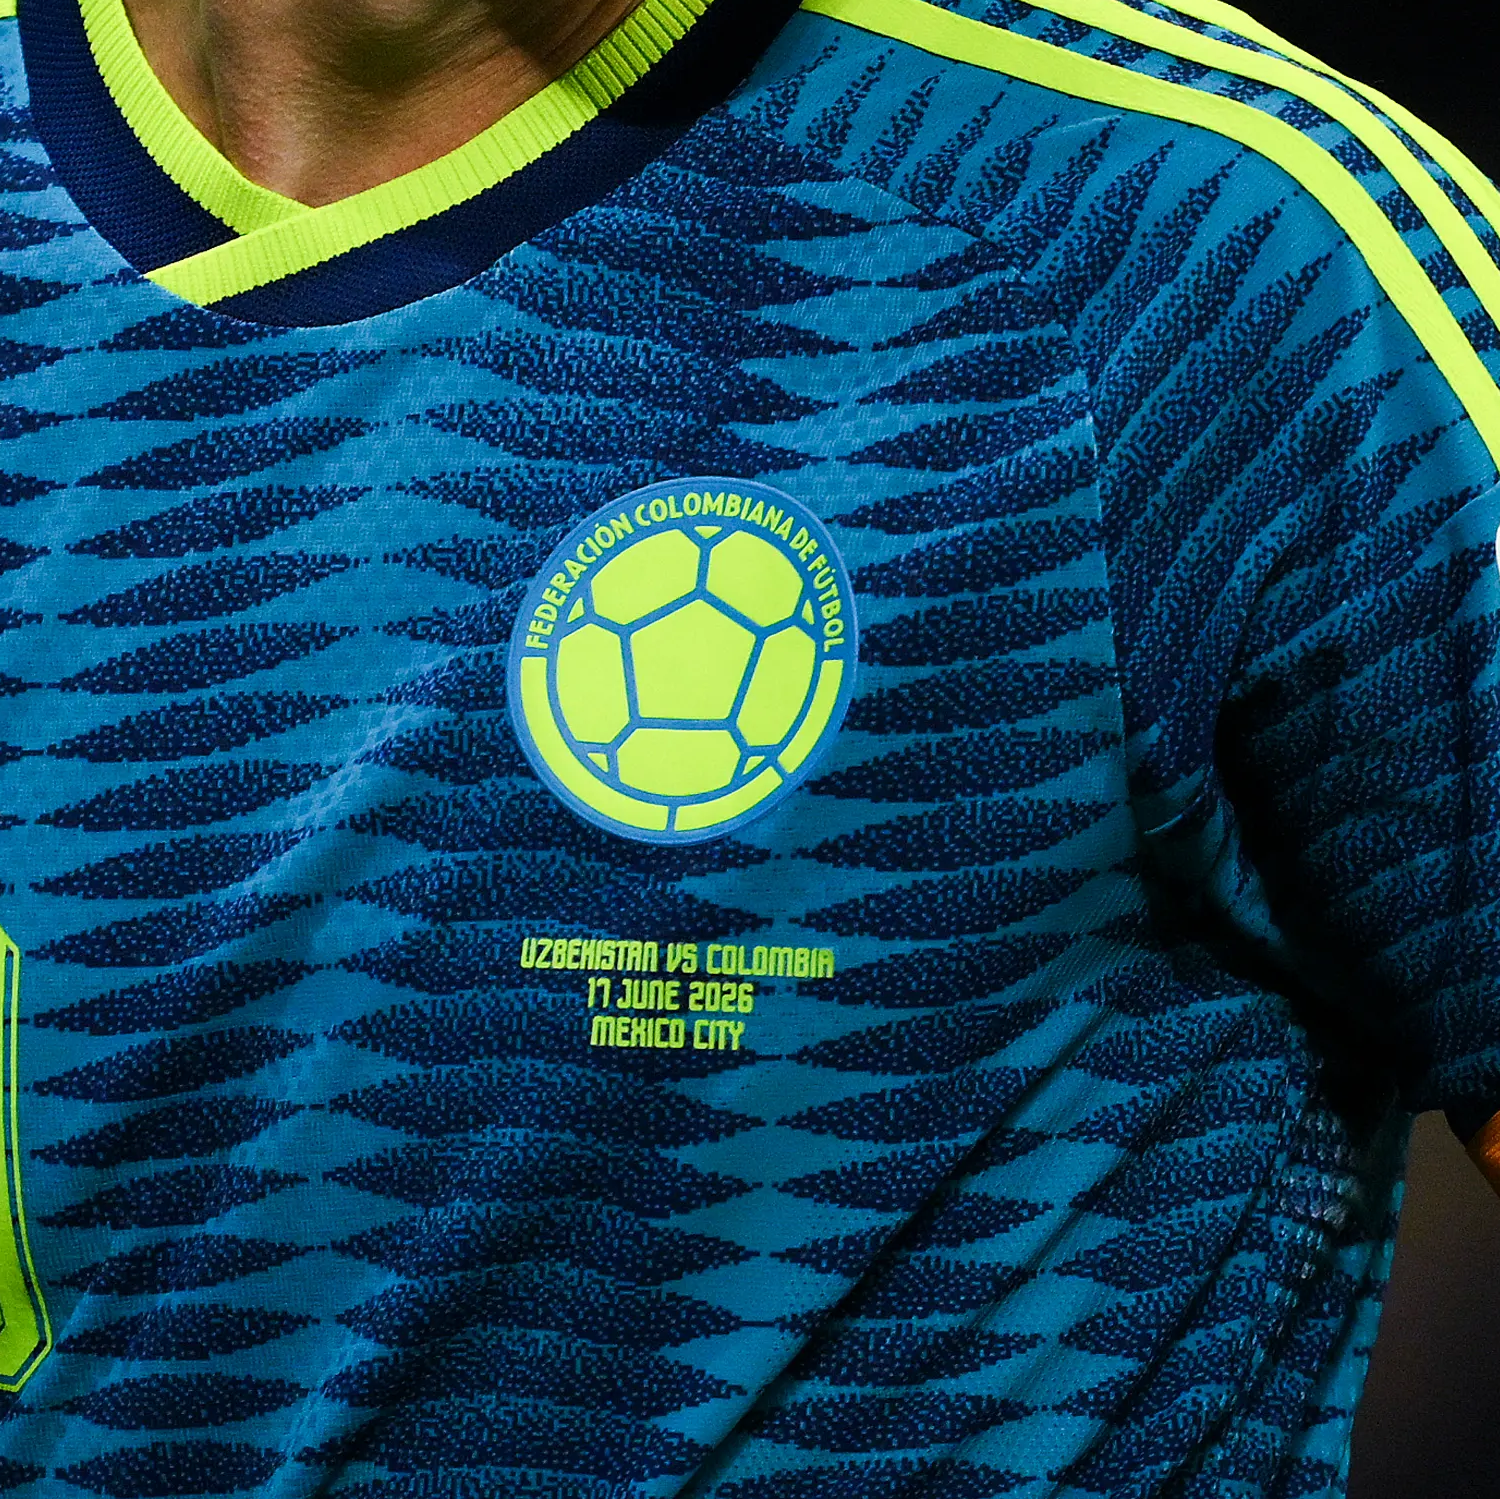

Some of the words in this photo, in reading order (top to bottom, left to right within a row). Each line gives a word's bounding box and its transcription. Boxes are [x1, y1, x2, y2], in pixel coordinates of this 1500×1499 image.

[525, 512, 635, 650] FEDERACIÓN
[634, 491, 795, 541] COLOMBIANA
[788, 526, 819, 563] DE
[806, 553, 846, 653] FÚTBOL
[520, 937, 659, 973] UZBEKISTAN
[666, 942, 698, 974] VS
[705, 943, 836, 979] COLOMBIA
[588, 976, 612, 1009] 17
[616, 978, 681, 1011] JUNE
[688, 981, 755, 1014] 2026
[590, 1014, 686, 1049] MEXICO
[693, 1019, 746, 1051] CITY
